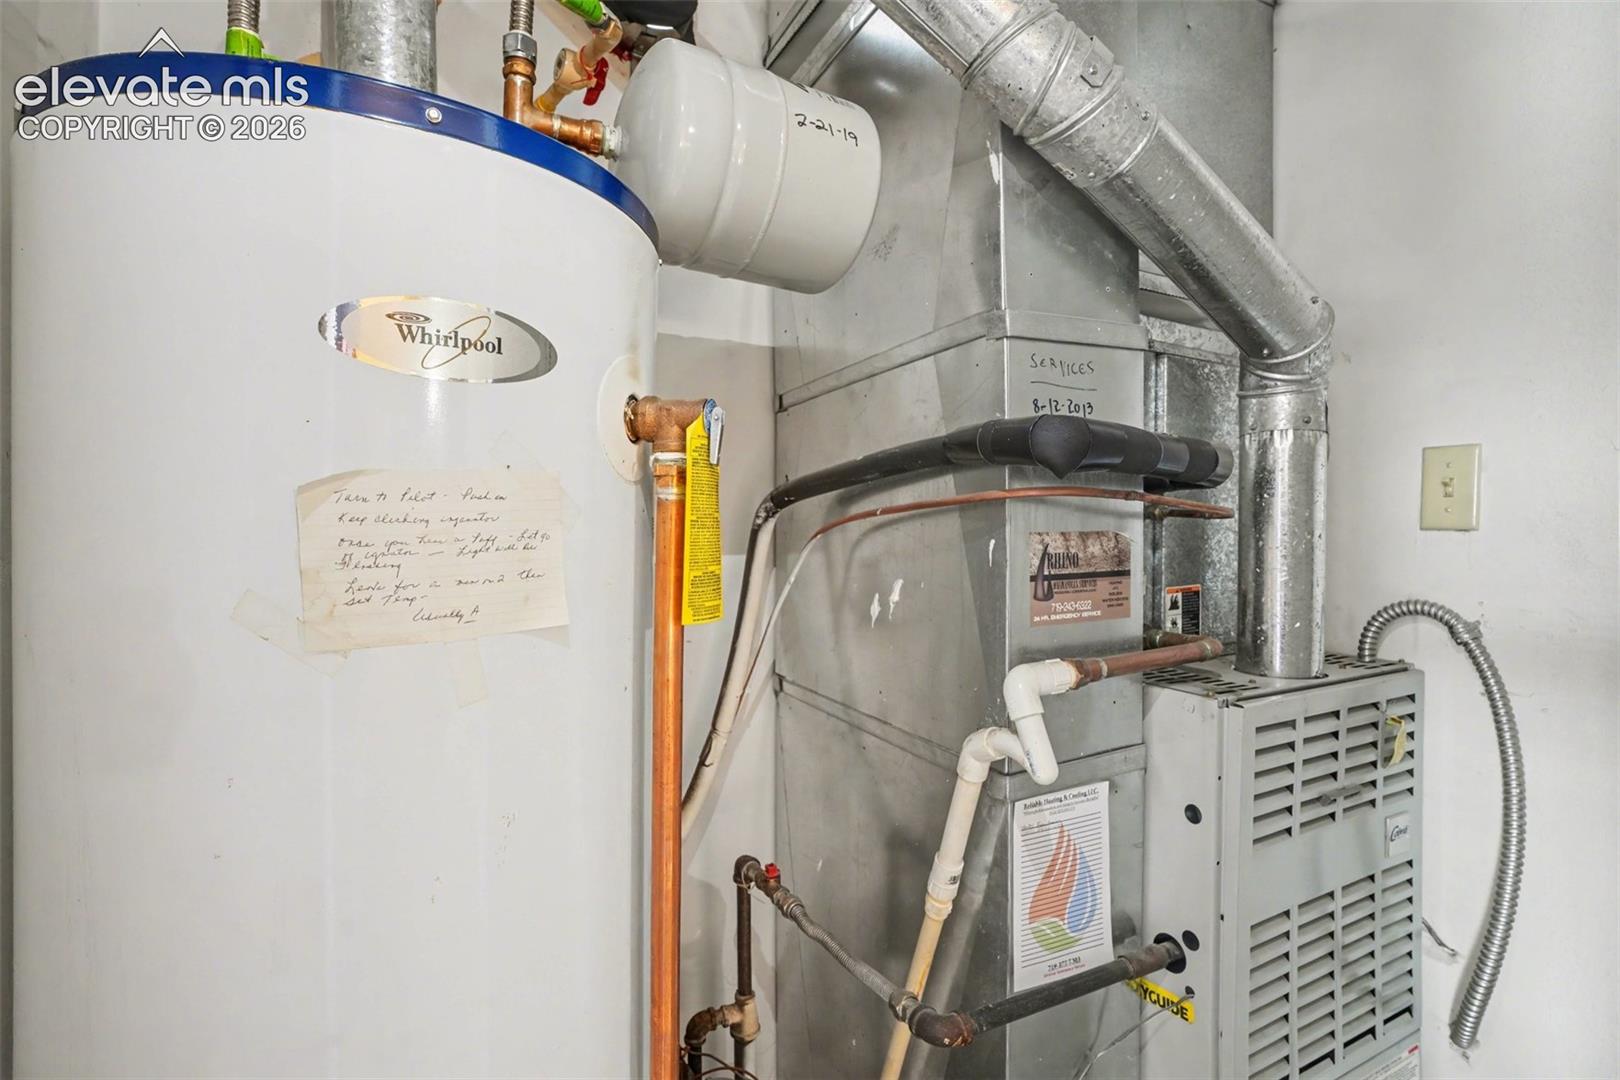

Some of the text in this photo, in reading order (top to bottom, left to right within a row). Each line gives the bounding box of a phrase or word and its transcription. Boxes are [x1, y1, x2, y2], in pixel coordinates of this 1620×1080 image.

[794, 113, 859, 147] 2-21-19
[394, 323, 503, 356] Whirlpool
[1029, 353, 1094, 377] SERVICES
